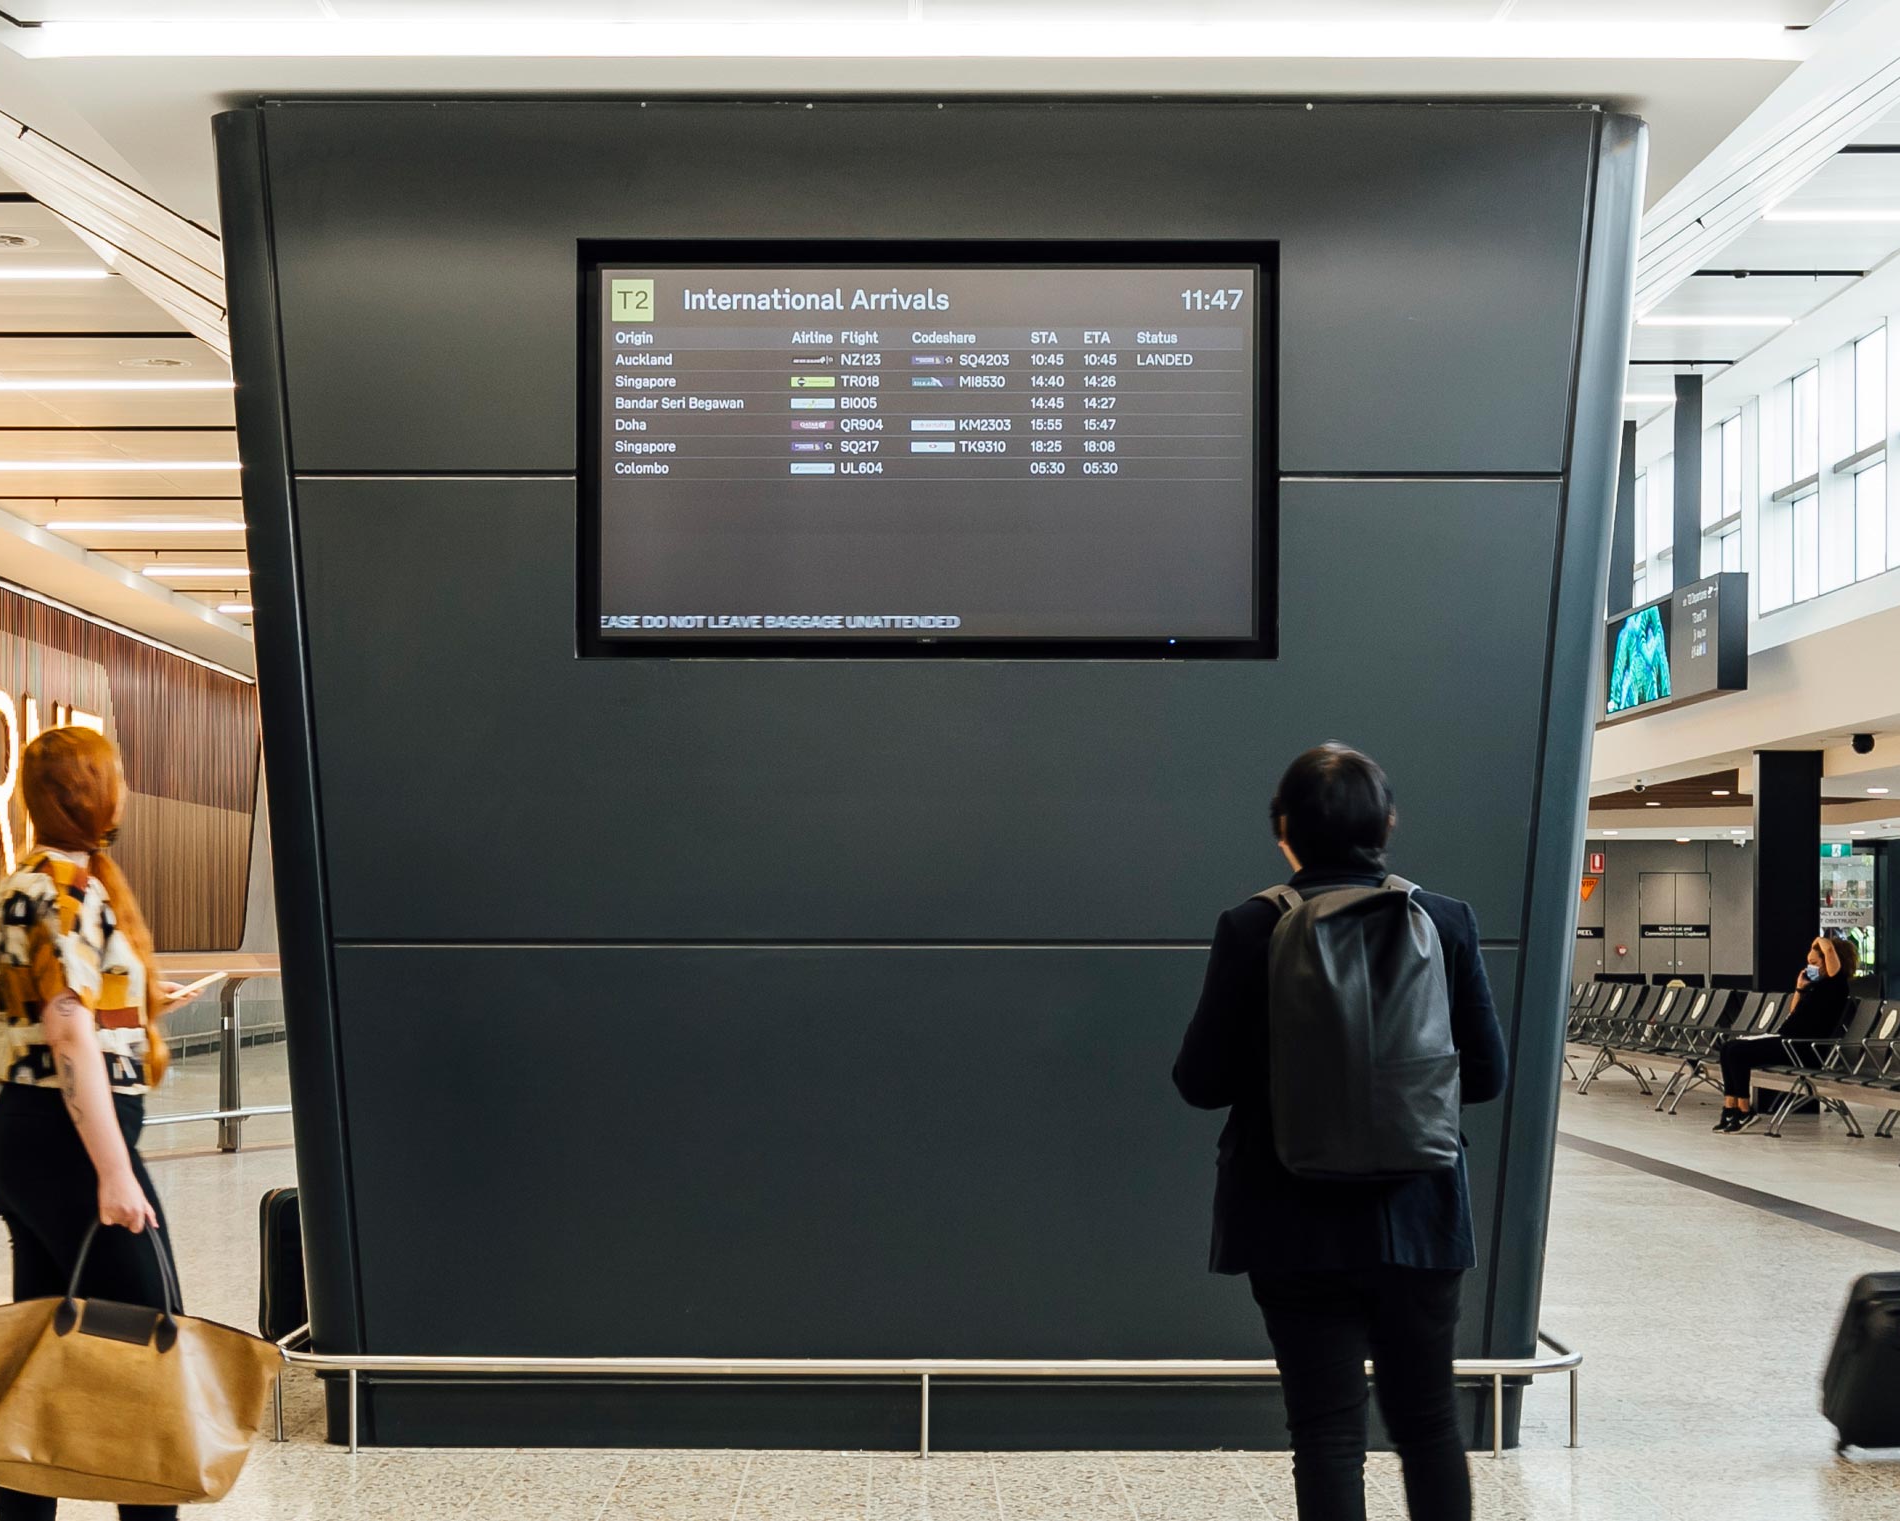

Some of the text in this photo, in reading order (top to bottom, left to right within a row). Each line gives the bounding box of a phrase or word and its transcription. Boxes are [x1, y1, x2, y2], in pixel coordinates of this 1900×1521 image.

[618, 291, 649, 310] T2
[684, 289, 949, 311] International Arrivals
[1181, 289, 1243, 311] 11:47
[615, 332, 1178, 345] Origin Airline Flight Codeshare STA ETA Status
[615, 354, 672, 366] Auckland
[841, 354, 881, 366] NZ123
[959, 354, 1009, 367] SQ4203
[1031, 354, 1064, 366] 10:45
[1084, 354, 1117, 366] 10:45
[1137, 354, 1193, 365] LANDED
[615, 376, 676, 389] Singapore
[841, 376, 879, 387] TR018
[959, 376, 1005, 387] MI8530
[1031, 376, 1064, 387] 14:40
[1084, 376, 1116, 387] 14:26
[615, 397, 1116, 411] Bandar Seri Begawan BI005 14:45 14:27
[615, 419, 646, 431] Doha
[840, 420, 883, 432] QR904
[959, 420, 1011, 431] KM2303
[1031, 420, 1062, 431] 15:55
[1084, 420, 1116, 431] 15:47
[615, 441, 1115, 454] Singapore SQ217 TK9310 18:25 18:08
[615, 462, 669, 474] Colombo
[840, 463, 883, 474] UL604
[1030, 463, 1065, 474] 05:30
[1083, 463, 1118, 474] 05:30
[601, 615, 960, 629] EASE DO NOT LEAVE BAGGAGE UNATTENDED
